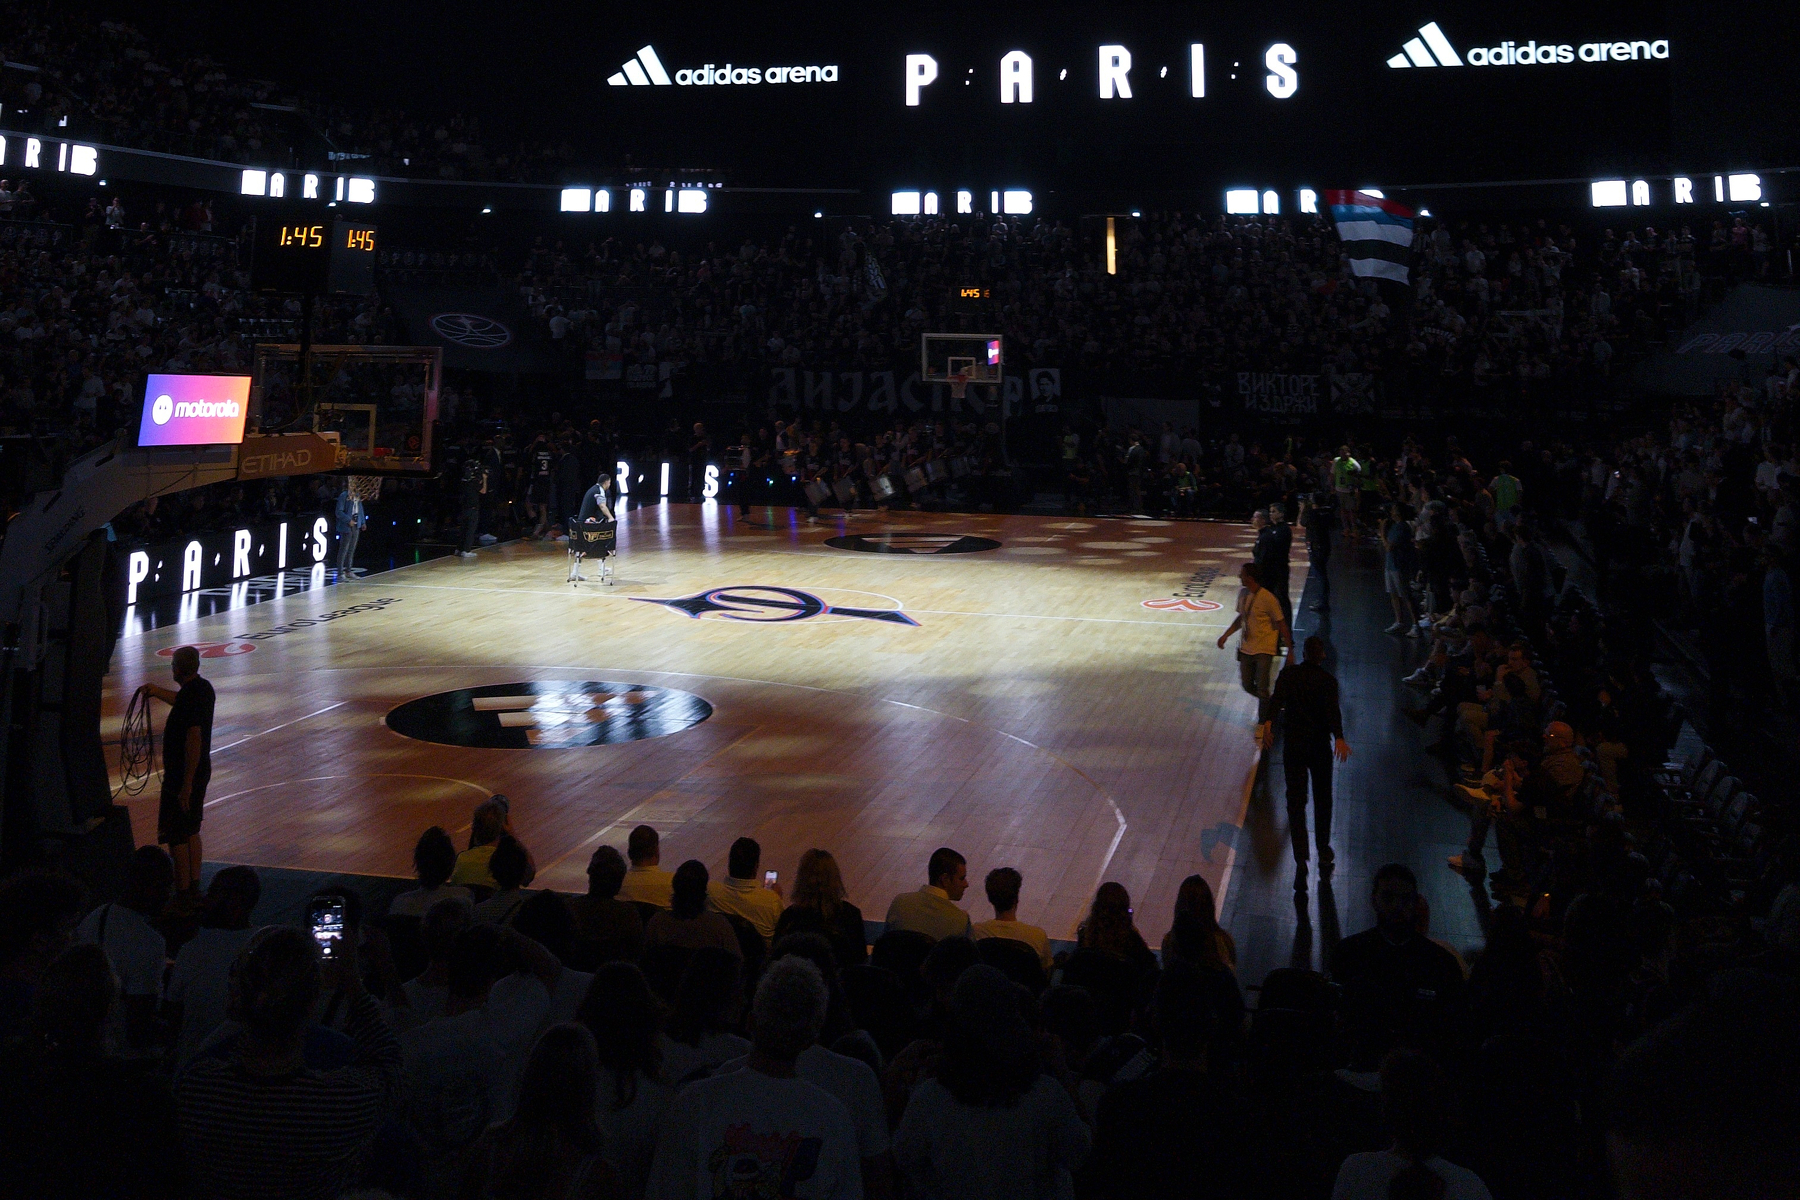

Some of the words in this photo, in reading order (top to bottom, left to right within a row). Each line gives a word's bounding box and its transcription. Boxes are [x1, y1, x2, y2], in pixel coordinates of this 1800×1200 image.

[1466, 40, 1574, 67] adidas
[1578, 39, 1669, 63] arena
[674, 63, 762, 86] adidas
[764, 63, 838, 84] arena
[280, 225, 323, 248] 1:45
[347, 229, 375, 252] 1:45
[174, 399, 240, 418] motorola
[241, 449, 312, 474] ETIHAD
